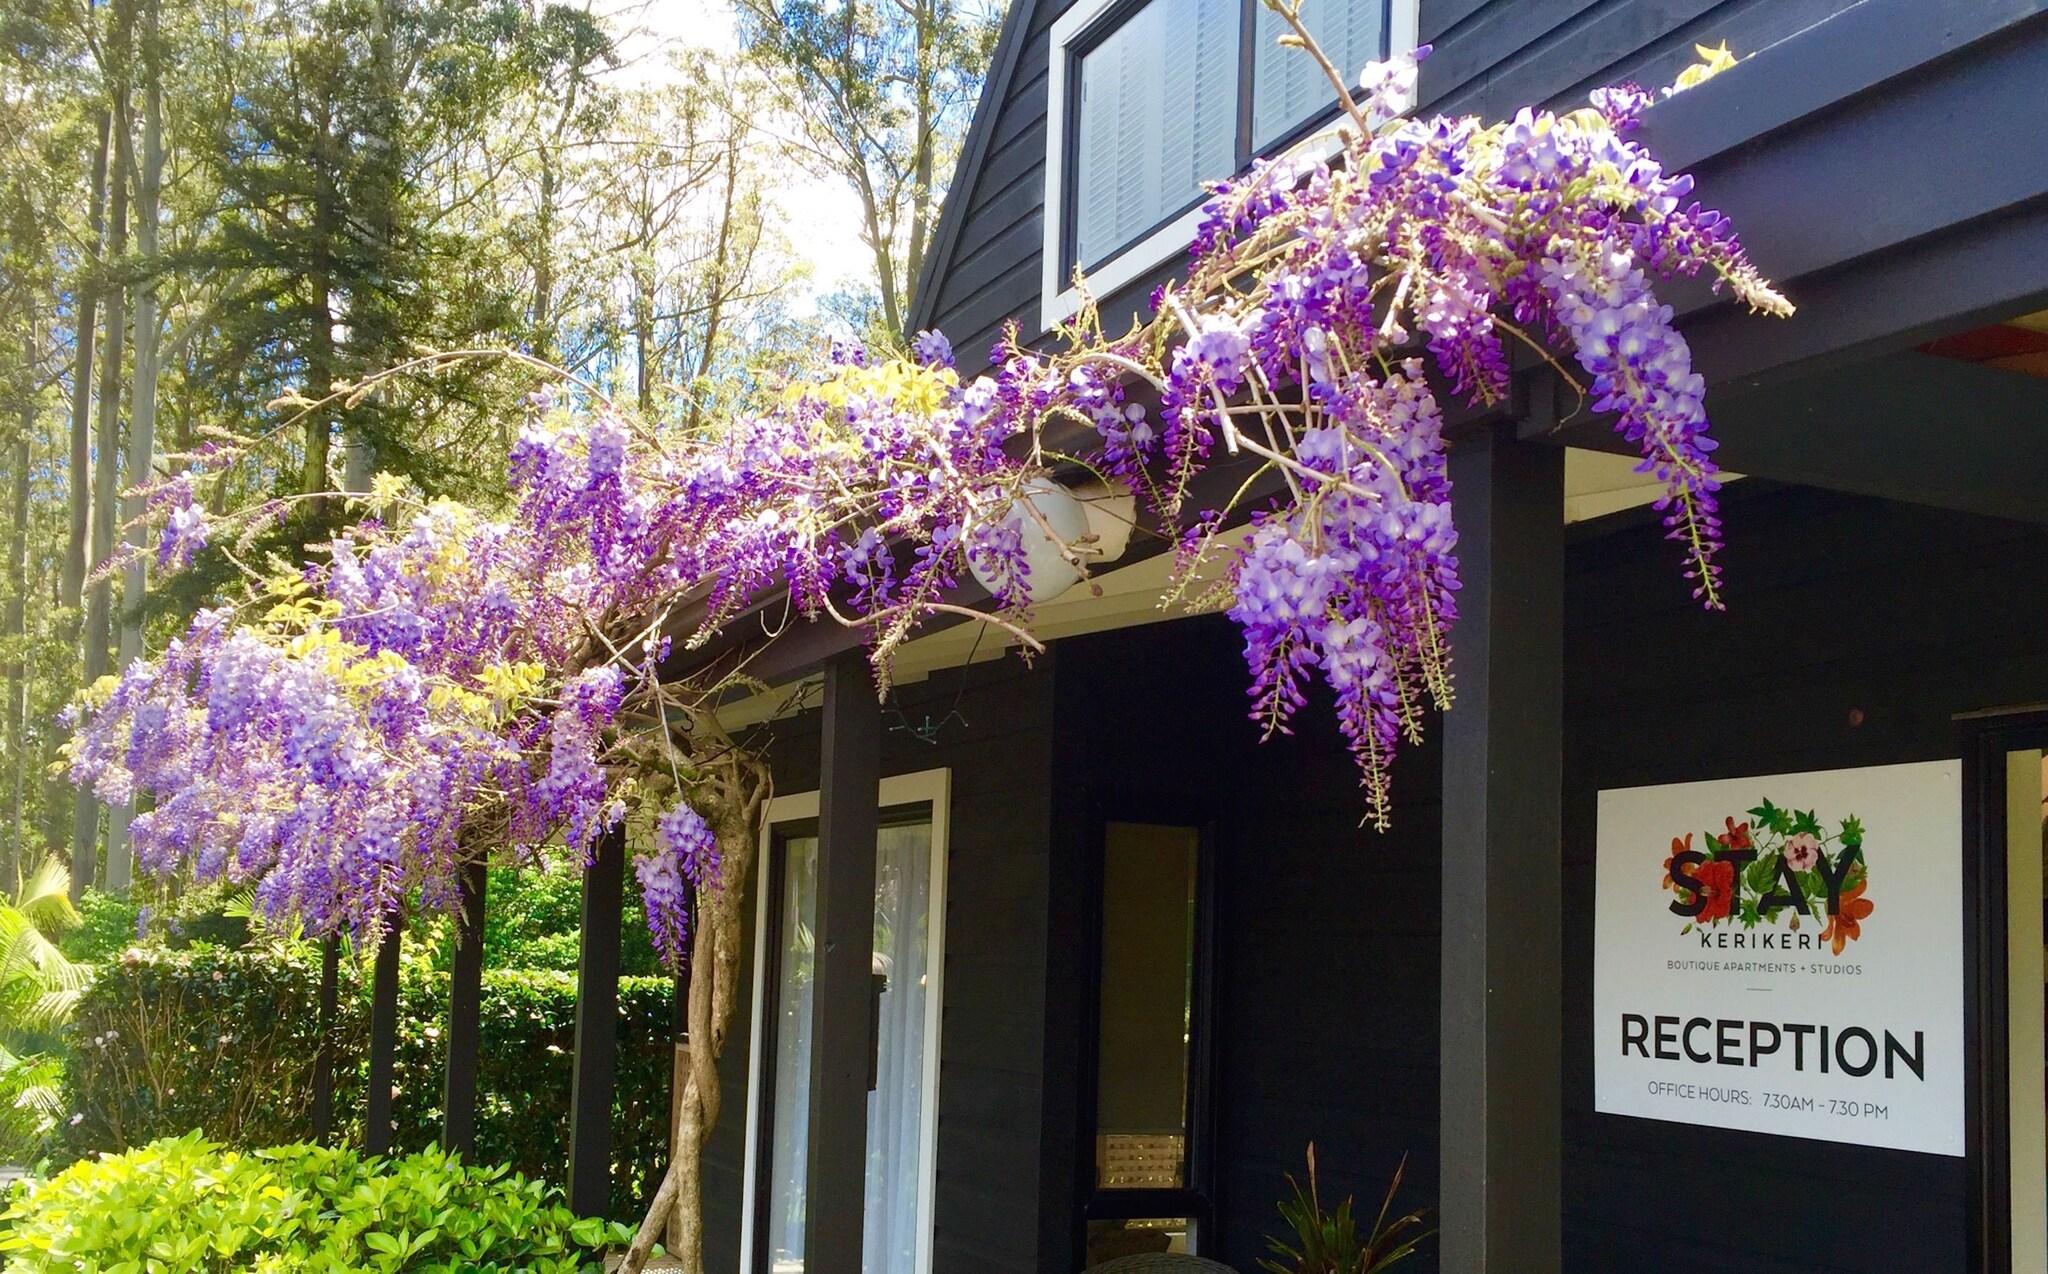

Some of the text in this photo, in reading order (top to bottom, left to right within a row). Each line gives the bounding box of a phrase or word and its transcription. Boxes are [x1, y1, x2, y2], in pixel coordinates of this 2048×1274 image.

[1669, 844, 1862, 917] STAY
[1700, 932, 1823, 950] KERIKERI
[1667, 960, 1720, 971] BOUTIQUE
[1723, 962, 1796, 973] APARTMENTS
[1810, 964, 1863, 975] STUDIOS
[1621, 1012, 1925, 1082] RECEPTION
[1648, 1080, 1696, 1099] OFFICE
[1698, 1086, 1752, 1105] HOURS:
[1863, 1103, 1888, 1120] PM
